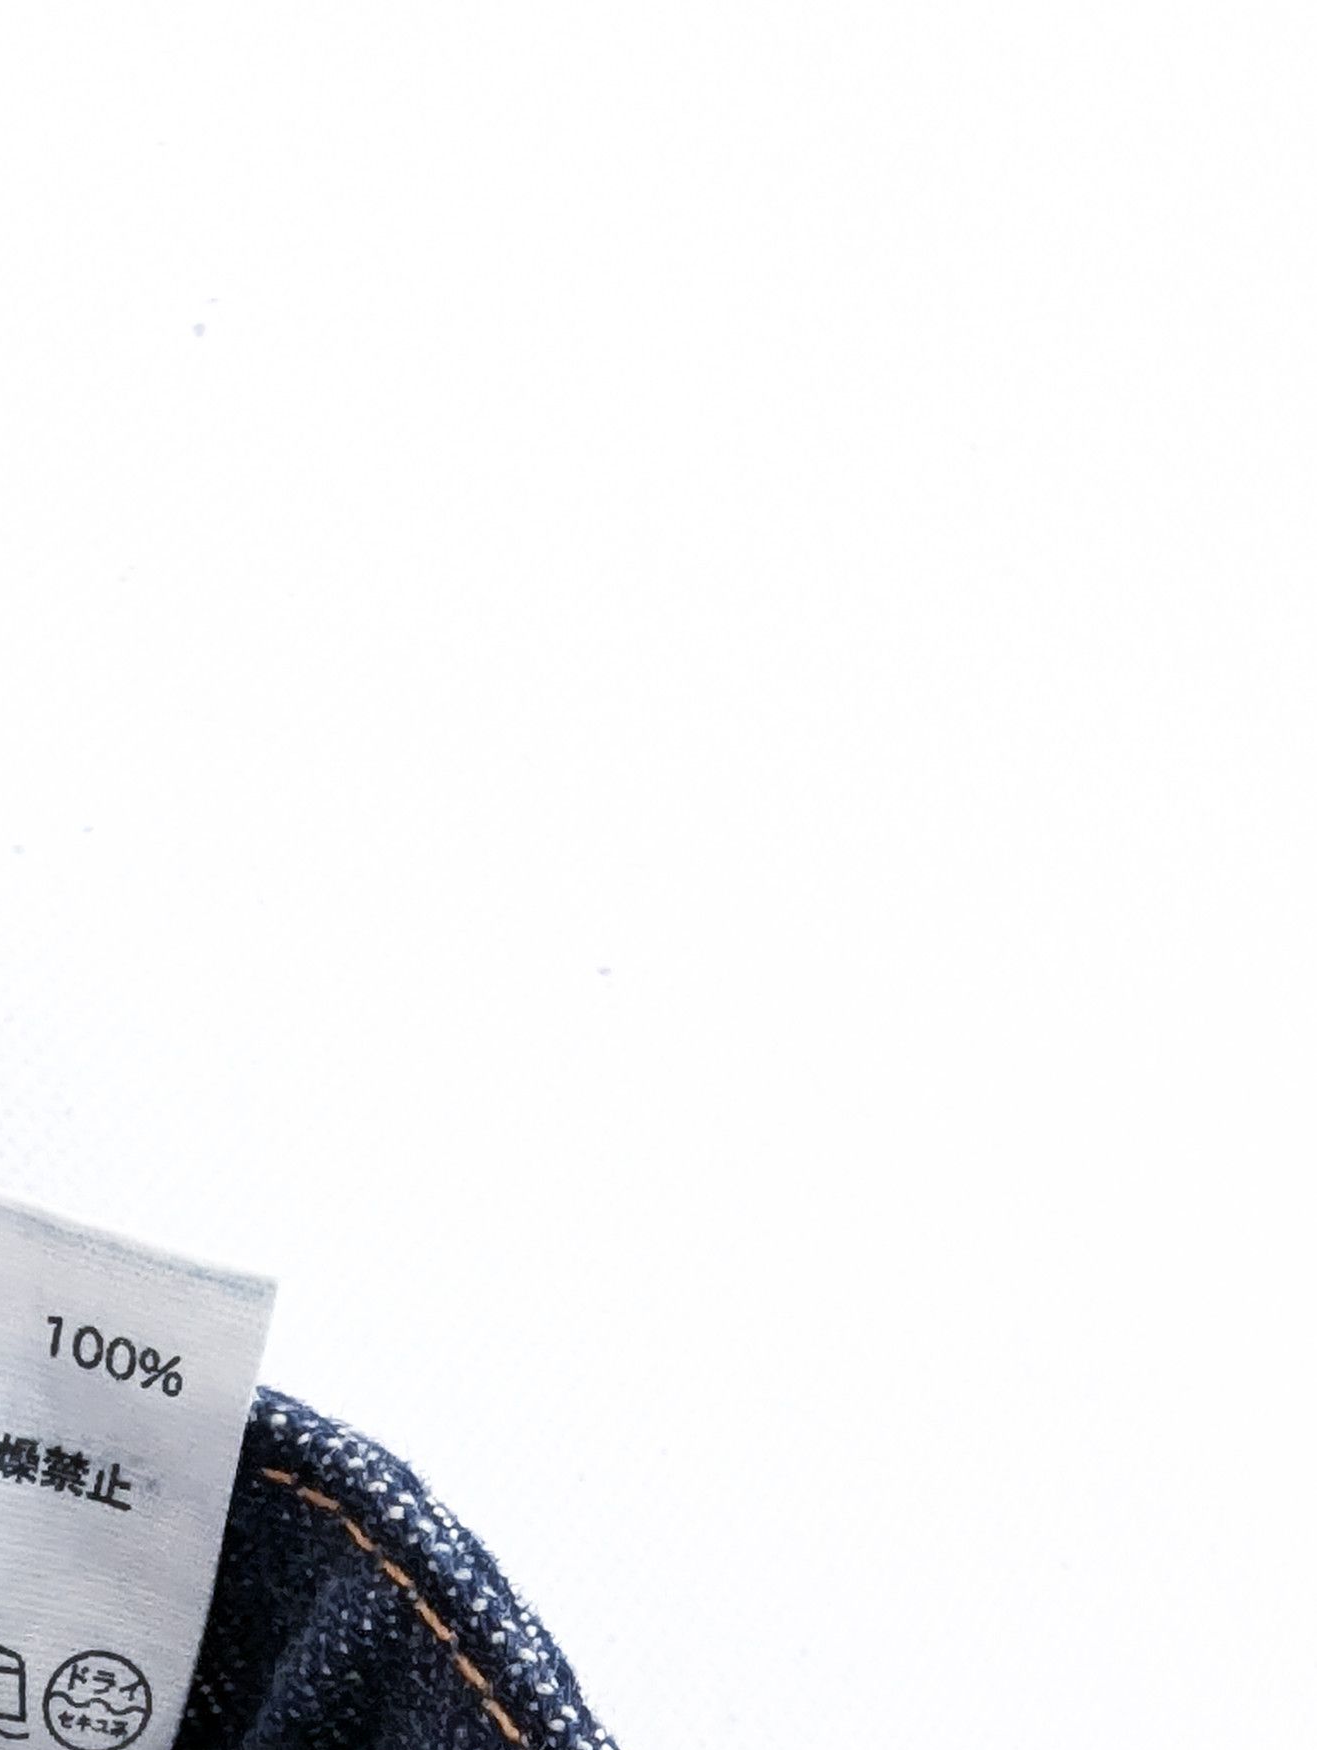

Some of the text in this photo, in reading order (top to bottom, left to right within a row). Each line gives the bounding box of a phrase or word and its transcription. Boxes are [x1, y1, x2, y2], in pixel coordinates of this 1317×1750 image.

[47, 1315, 184, 1398] 100%
[68, 1663, 142, 1701] ドライ
